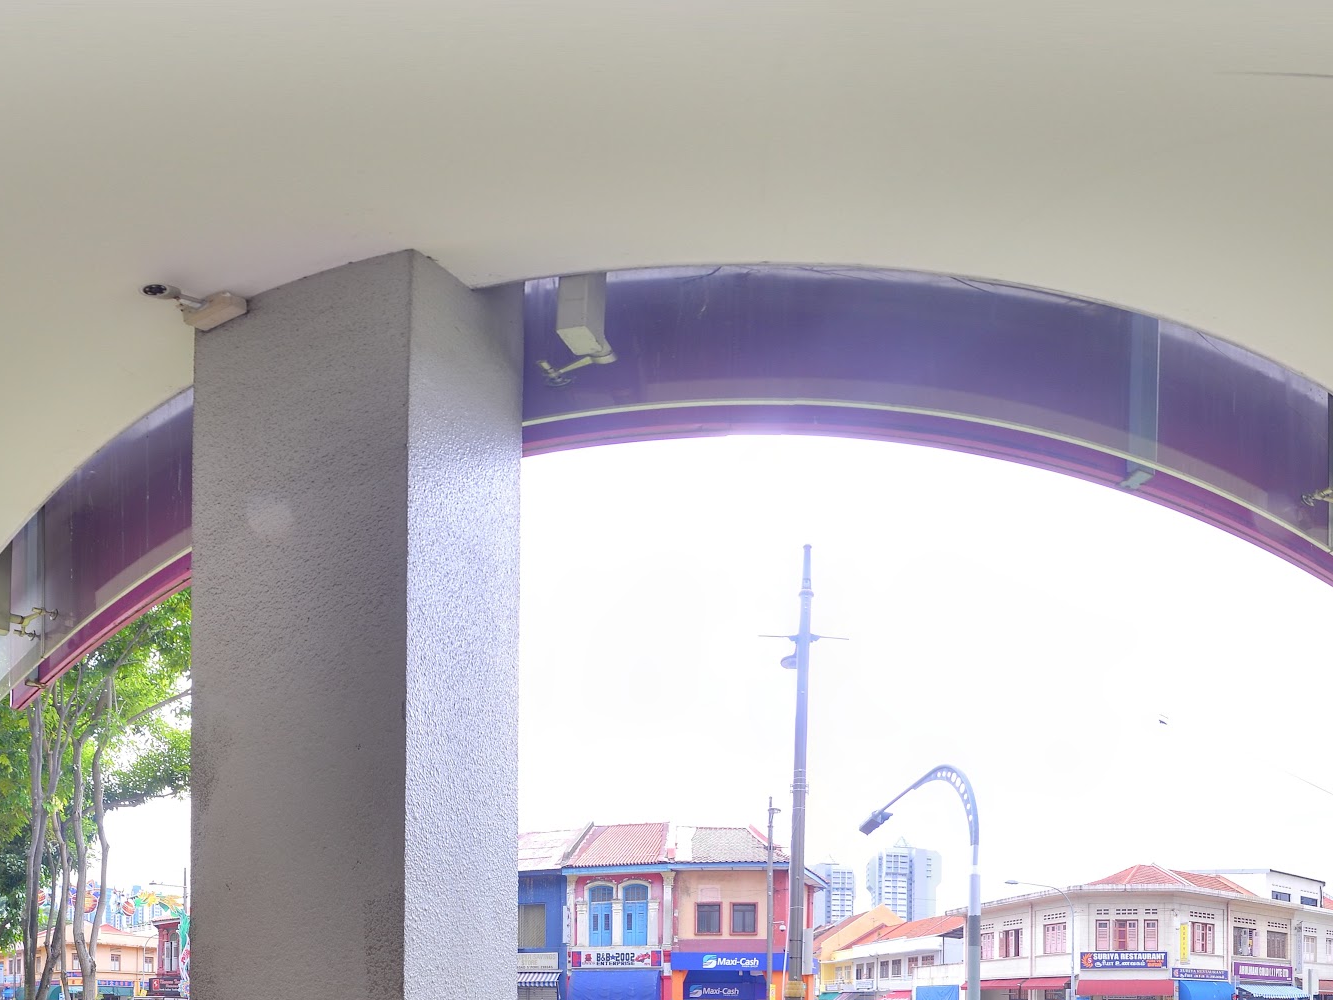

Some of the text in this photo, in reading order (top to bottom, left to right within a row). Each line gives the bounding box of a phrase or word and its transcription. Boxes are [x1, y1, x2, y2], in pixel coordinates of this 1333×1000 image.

[1120, 953, 1165, 961] RESTAURANT
[717, 957, 759, 966] Maxi-Cash
[702, 987, 739, 995] Maxi-Cash
